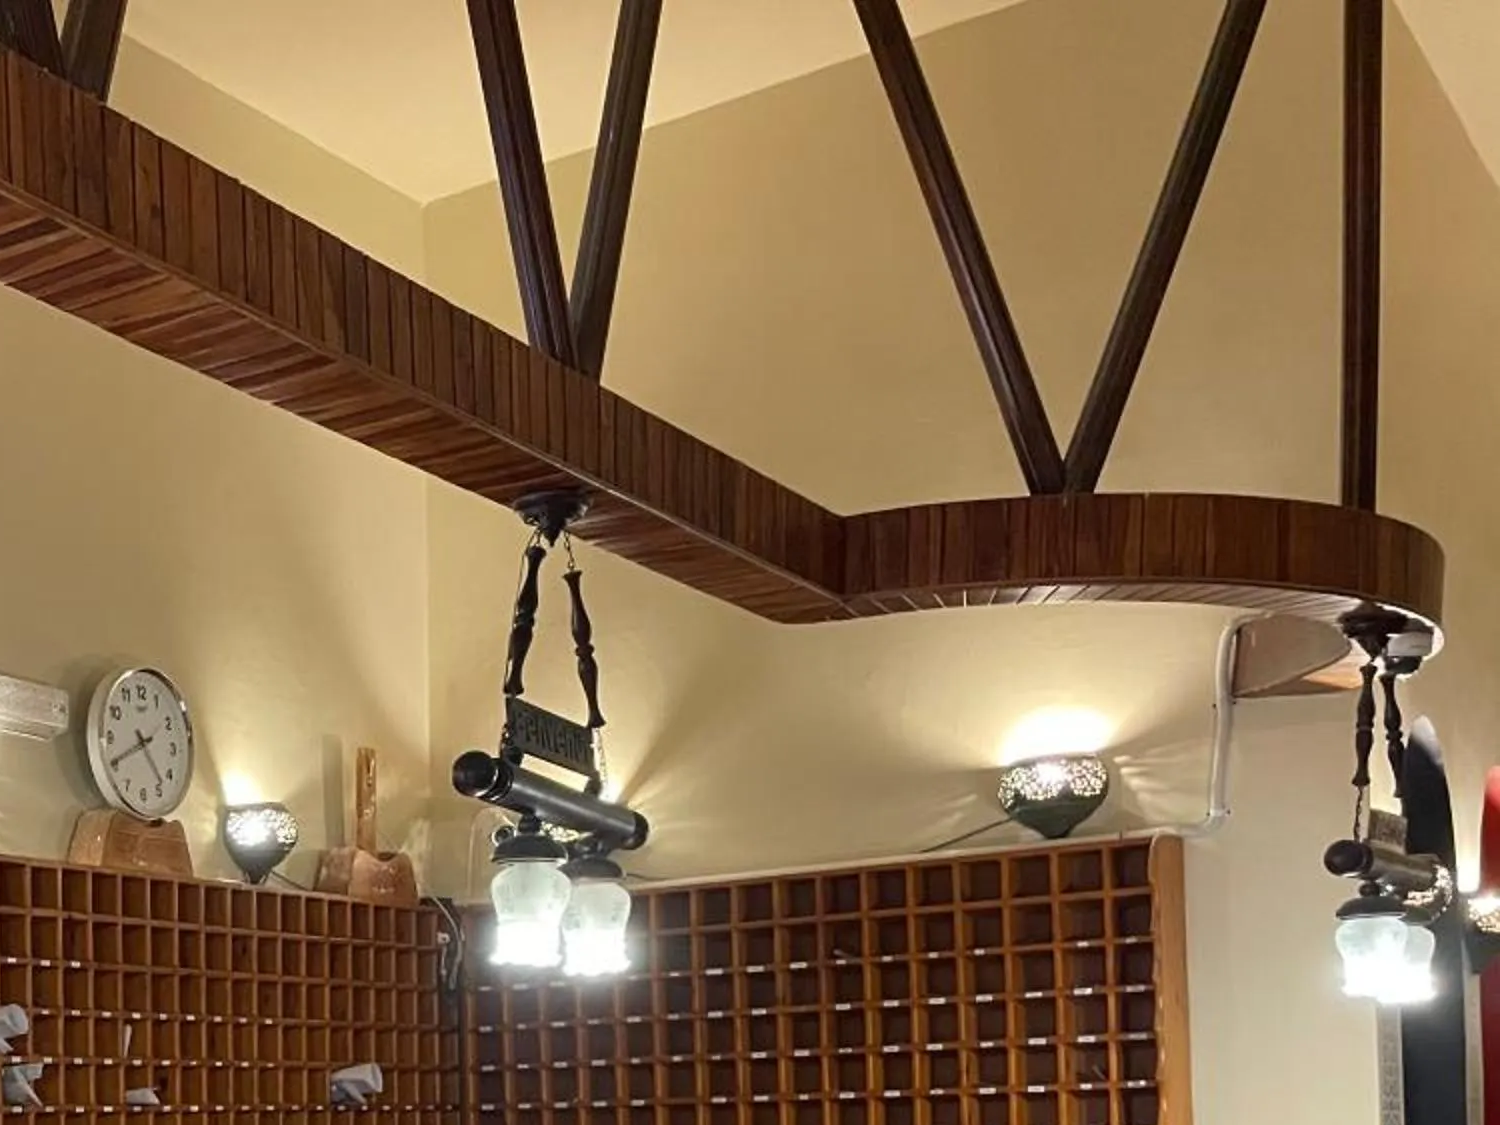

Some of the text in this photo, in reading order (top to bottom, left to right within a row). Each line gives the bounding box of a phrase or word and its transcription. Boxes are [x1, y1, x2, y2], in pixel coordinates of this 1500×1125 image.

[122, 687, 131, 703] 11
[136, 685, 147, 701] 12
[110, 705, 122, 721] 10
[166, 716, 172, 731] 2
[107, 730, 114, 744] 9
[170, 742, 176, 757] 3
[166, 768, 173, 781] 4
[122, 778, 131, 793] 7
[155, 782, 163, 798] 5
[140, 787, 147, 802] 6
